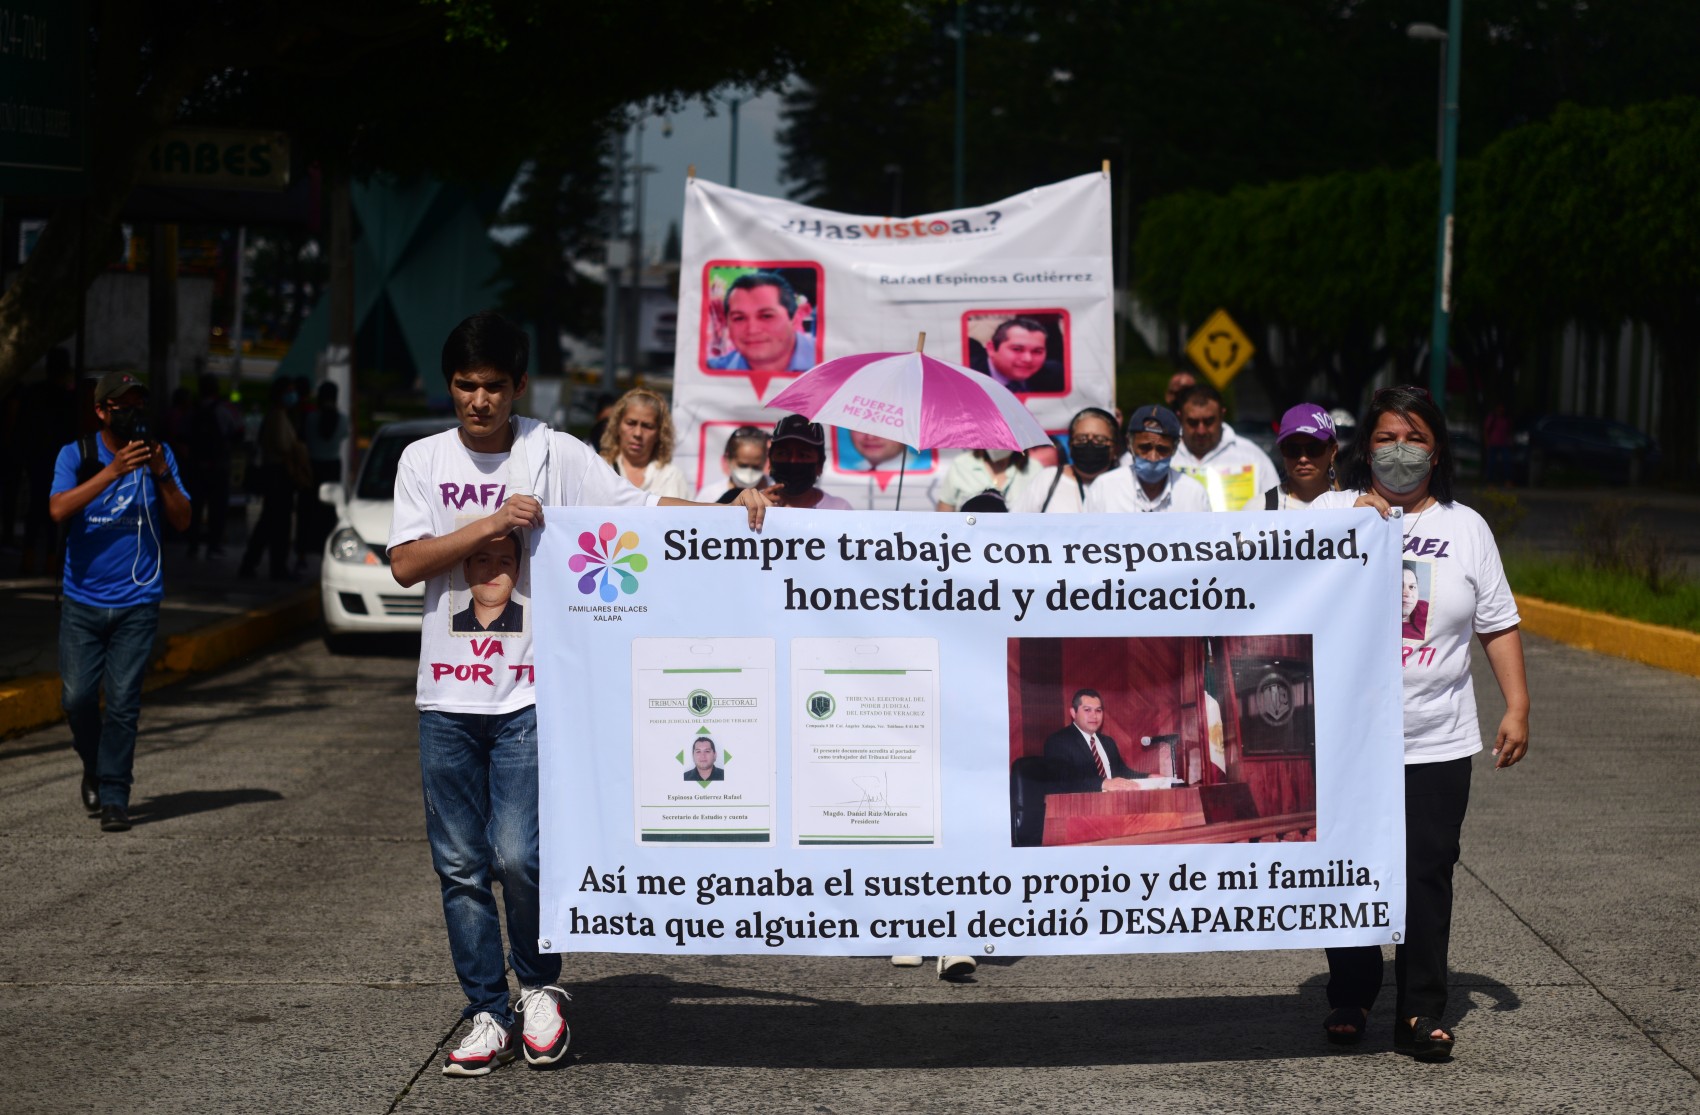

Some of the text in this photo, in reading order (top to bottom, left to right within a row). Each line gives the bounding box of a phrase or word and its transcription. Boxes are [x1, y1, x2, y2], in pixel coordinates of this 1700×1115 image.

[880, 271, 1093, 287] Rafael Espinosa Gutiérrez
[852, 395, 904, 417] FUERZA
[664, 528, 1368, 572] Siempre trabaje con responsabilidad,
[1402, 534, 1450, 558] AEL
[568, 605, 648, 613] FAMILIARES ENLACES
[784, 576, 1256, 622] honestidad y dedicación.
[593, 614, 623, 622] XALAPA
[469, 637, 505, 660] VA
[1418, 647, 1437, 667] TI
[431, 662, 495, 686] POR
[650, 698, 755, 707] TRIBUNAL ELECTORAL
[667, 794, 693, 802] Espinosa
[578, 860, 1380, 906] Así me ganaba el sustento propio y de mi familia,
[569, 902, 1390, 948] hasta que alguien cruel decidió DESAPARECERME
